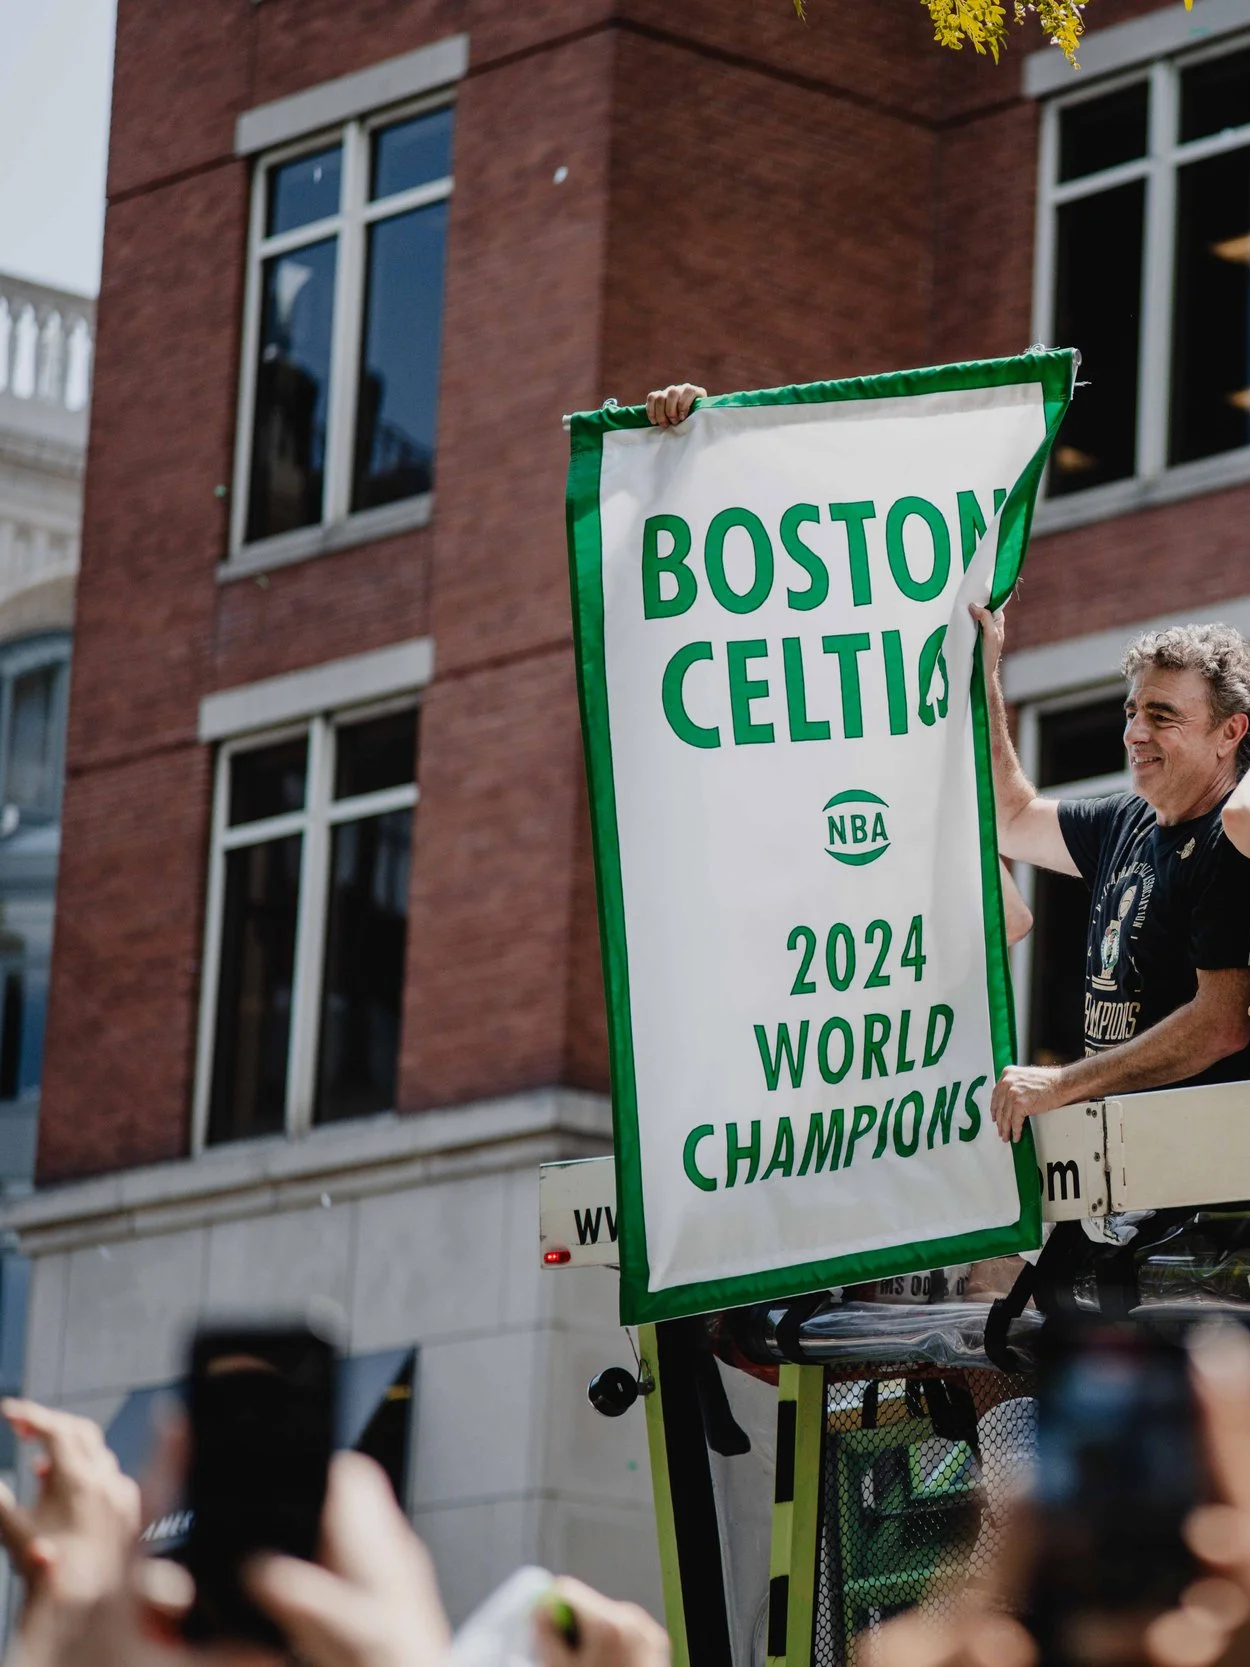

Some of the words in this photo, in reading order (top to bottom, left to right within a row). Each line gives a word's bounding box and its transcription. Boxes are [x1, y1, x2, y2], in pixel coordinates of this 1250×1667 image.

[827, 811, 889, 846] NBA
[786, 914, 927, 996] 2024
[753, 1003, 955, 1092] WORLD
[682, 1074, 988, 1192] CHAMPIONS
